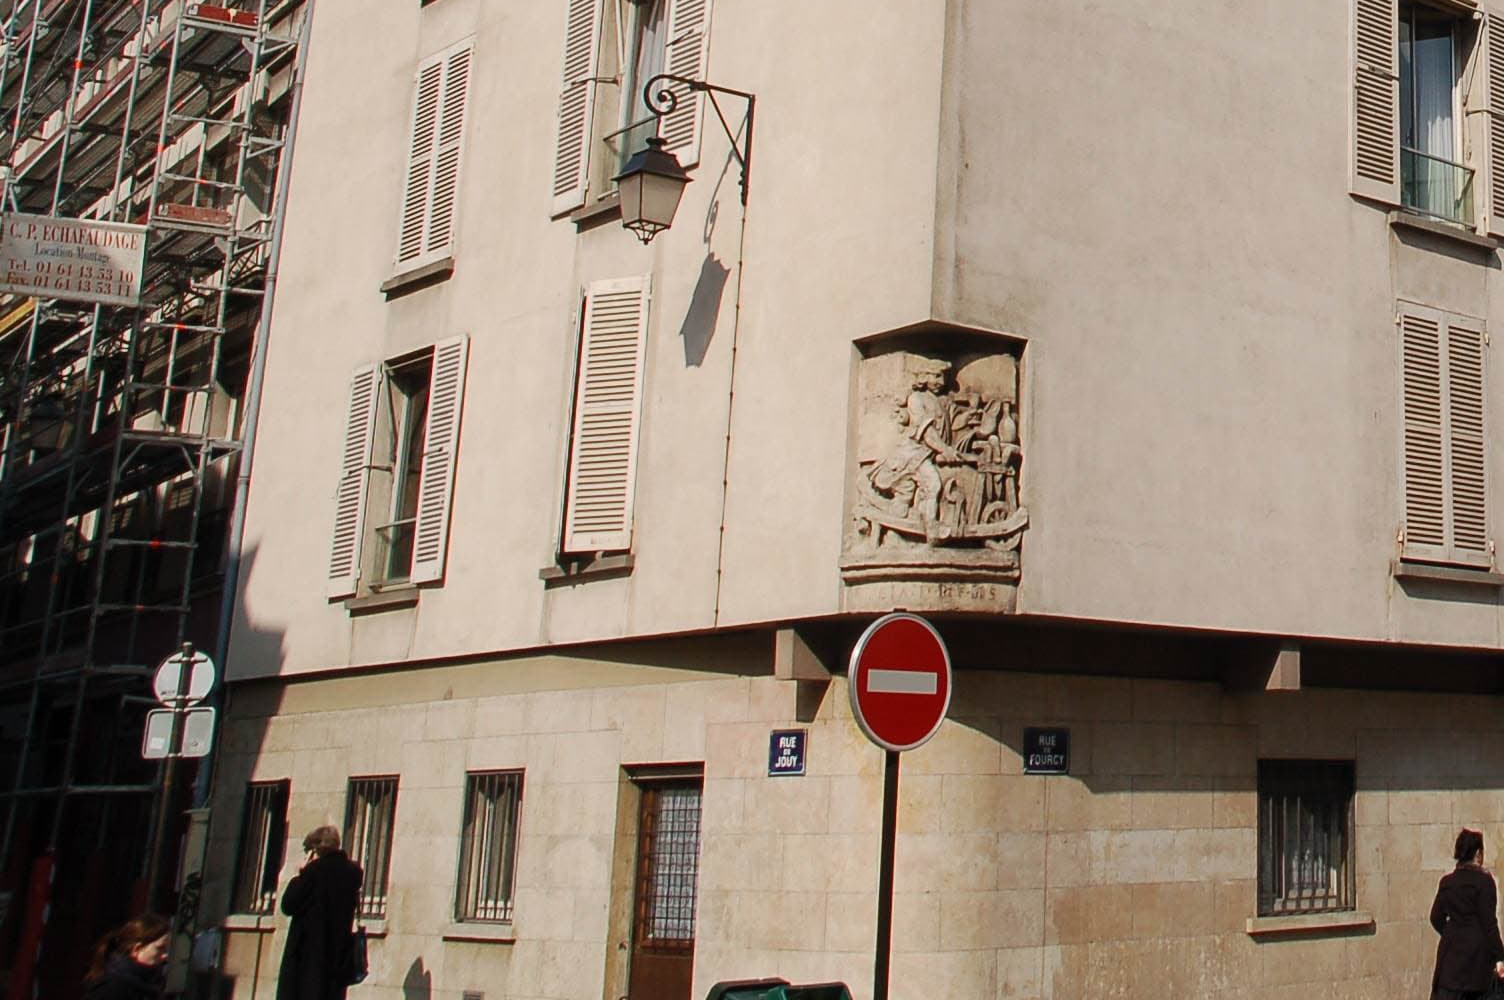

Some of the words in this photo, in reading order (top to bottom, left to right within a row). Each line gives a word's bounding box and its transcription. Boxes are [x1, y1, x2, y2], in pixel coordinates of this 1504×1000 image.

[27, 223, 37, 240] P.
[36, 261, 52, 274] 01
[96, 268, 113, 281] 53
[119, 269, 134, 283] 10
[95, 281, 112, 294] 53
[779, 736, 797, 748] RUE
[1038, 735, 1056, 746] RUE
[775, 755, 798, 768] JOUY
[1029, 753, 1065, 766] FOURCY
